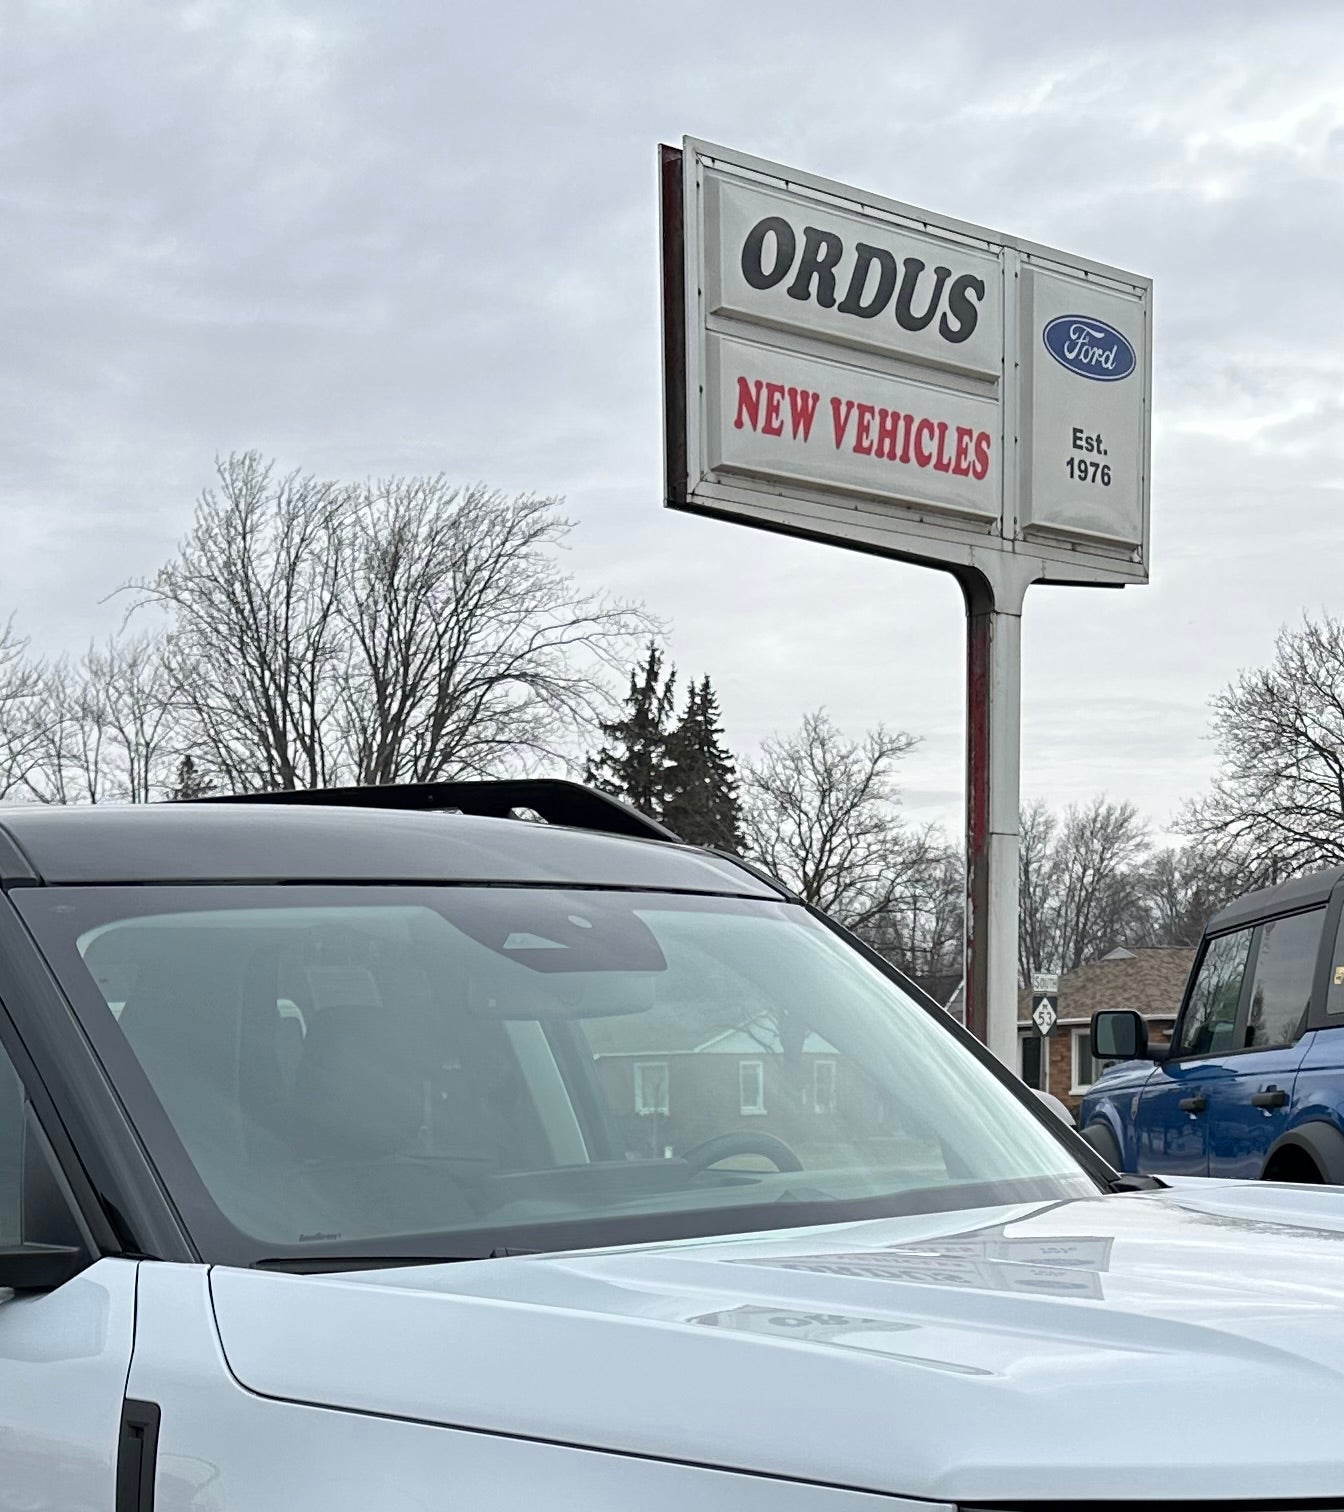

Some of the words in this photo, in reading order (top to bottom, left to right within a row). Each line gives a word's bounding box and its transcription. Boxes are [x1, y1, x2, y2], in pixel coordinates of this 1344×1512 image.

[741, 216, 985, 343] ORDUS
[1064, 323, 1117, 371] Ford
[734, 376, 820, 444] NEW
[830, 396, 991, 480] VEHICLES
[1071, 427, 1109, 456] Est.
[1066, 457, 1111, 487] 1976
[1038, 1011, 1052, 1026] 53
